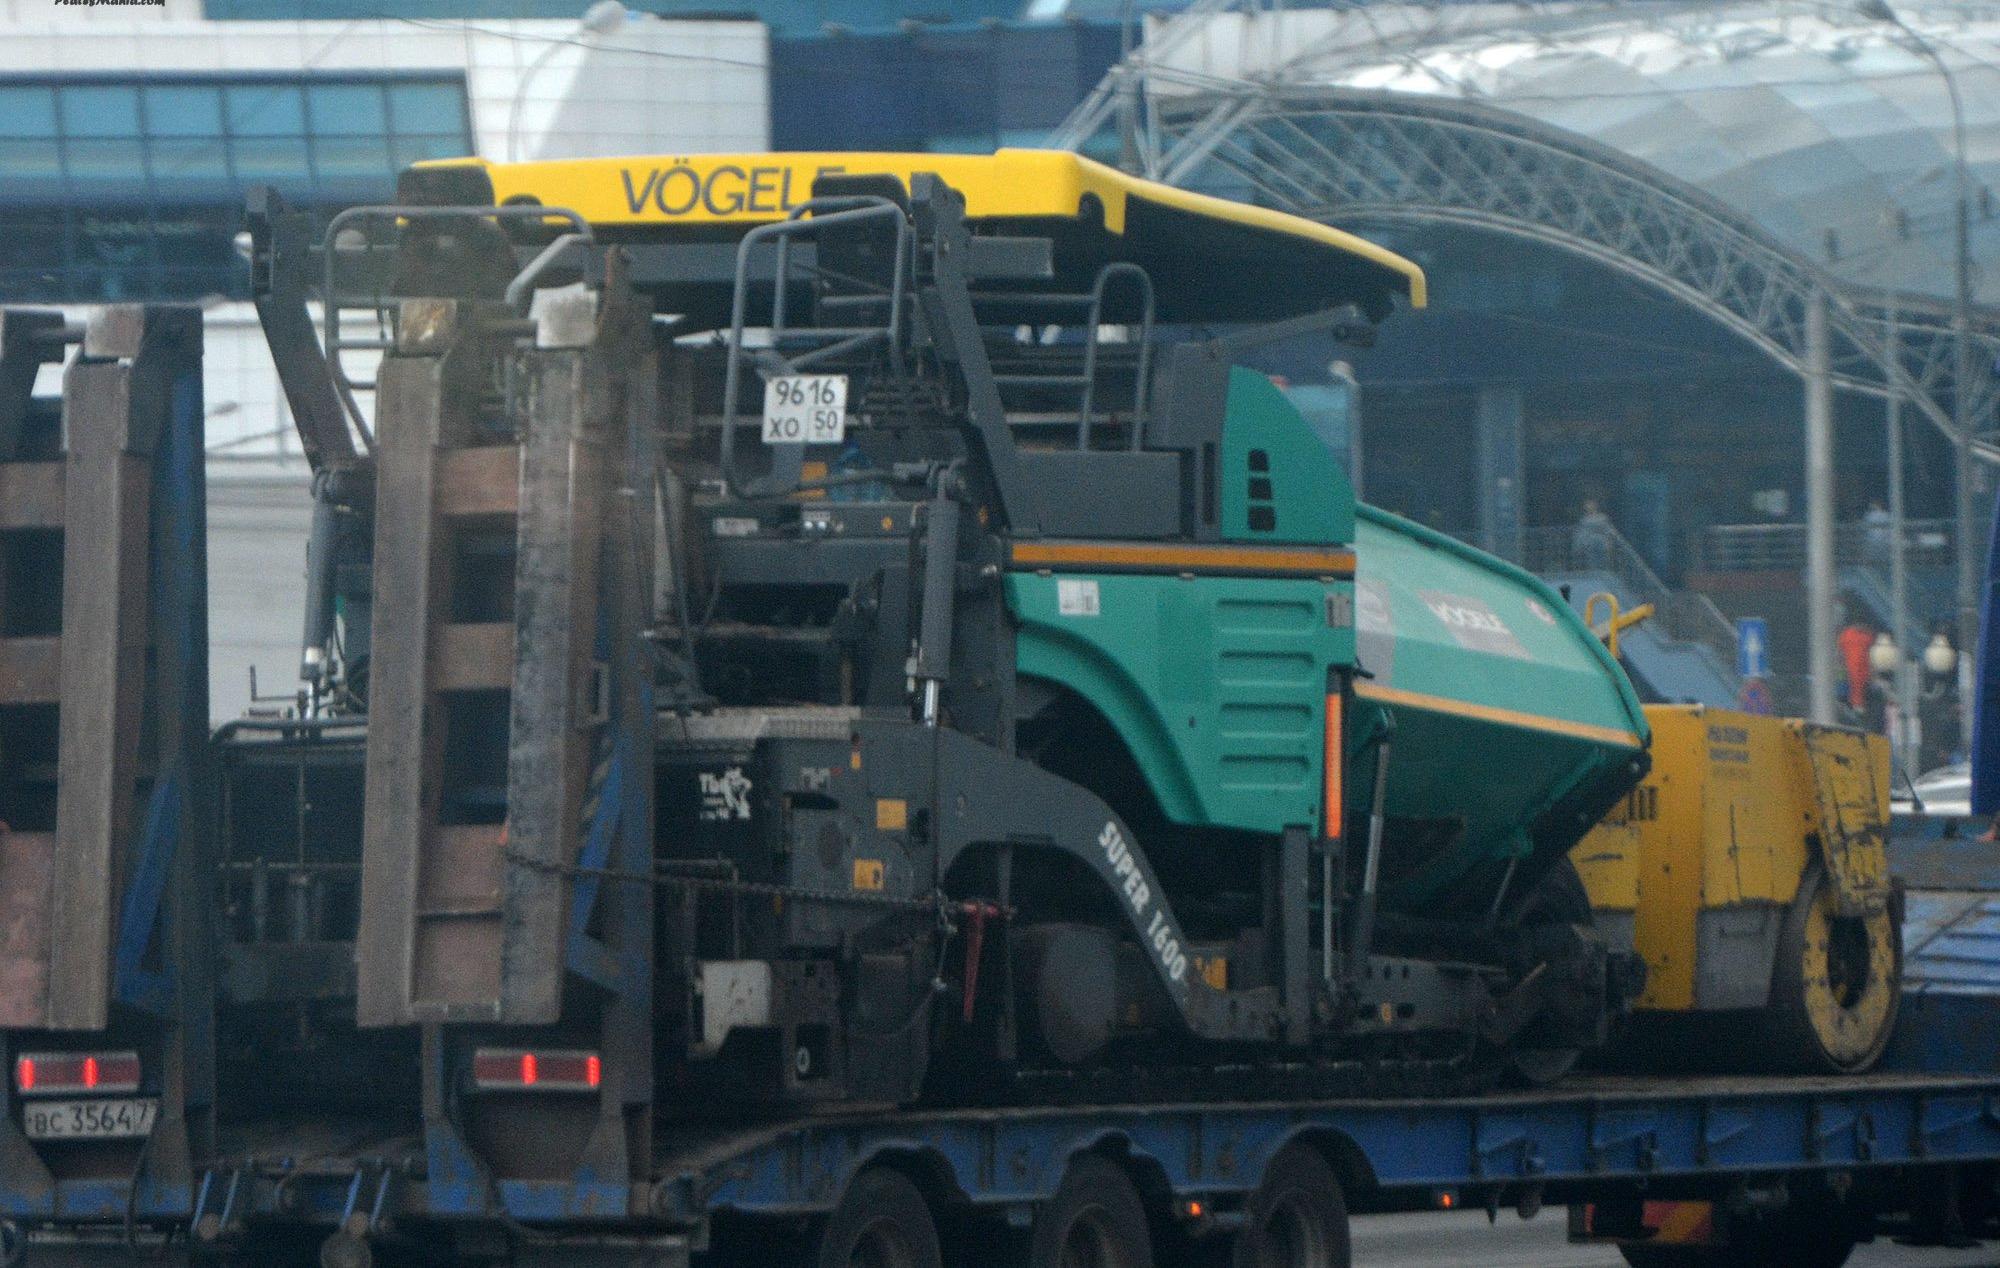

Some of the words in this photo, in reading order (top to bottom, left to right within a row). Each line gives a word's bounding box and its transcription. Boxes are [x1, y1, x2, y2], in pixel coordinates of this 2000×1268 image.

[620, 157, 846, 216] VÖGEL
[815, 410, 838, 431] 50
[1098, 821, 1150, 914] SUPER
[1148, 910, 1187, 980] 1600
